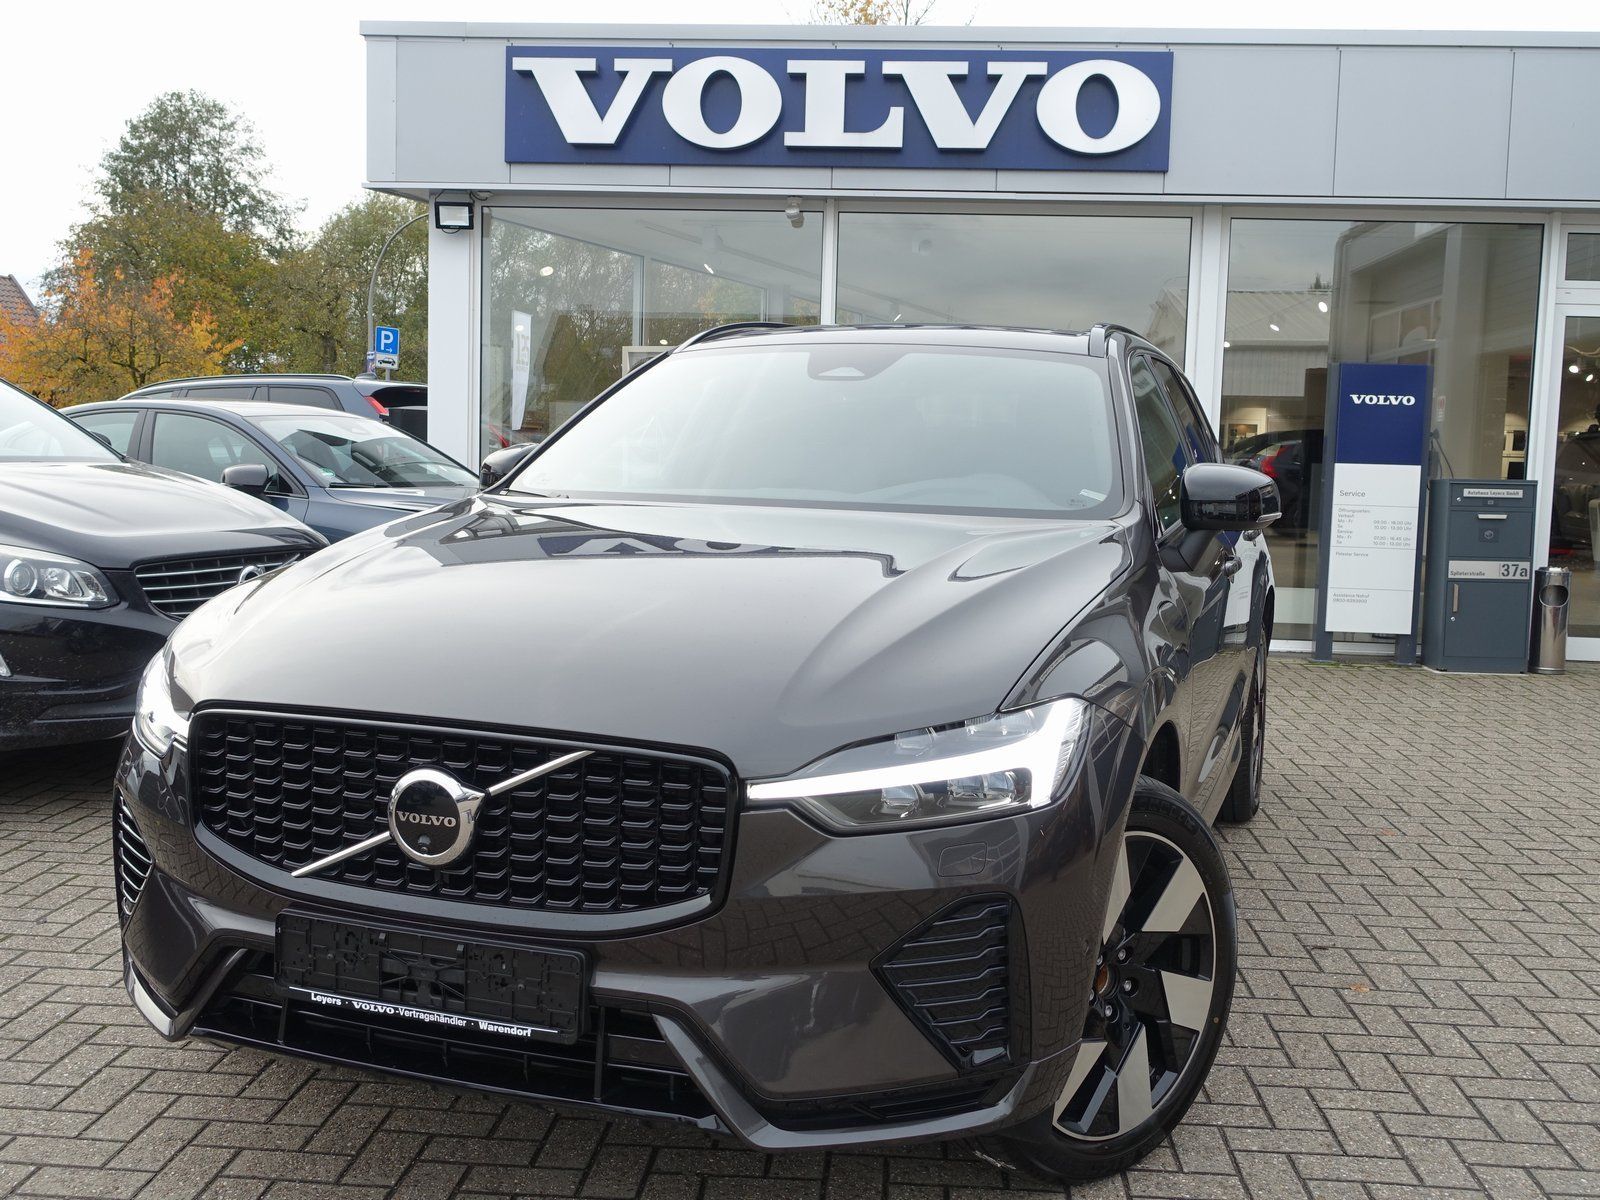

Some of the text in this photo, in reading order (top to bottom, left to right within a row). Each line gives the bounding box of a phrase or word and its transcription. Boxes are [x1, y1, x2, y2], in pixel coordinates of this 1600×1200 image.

[511, 55, 1162, 155] VOLVO
[380, 330, 394, 350] P
[1350, 394, 1416, 406] VOLVO
[1339, 489, 1366, 497] Service
[1501, 563, 1528, 577] 37a
[396, 810, 457, 827] VOLVO
[310, 992, 342, 1006] Leyers
[478, 1021, 532, 1038] Warendorf
